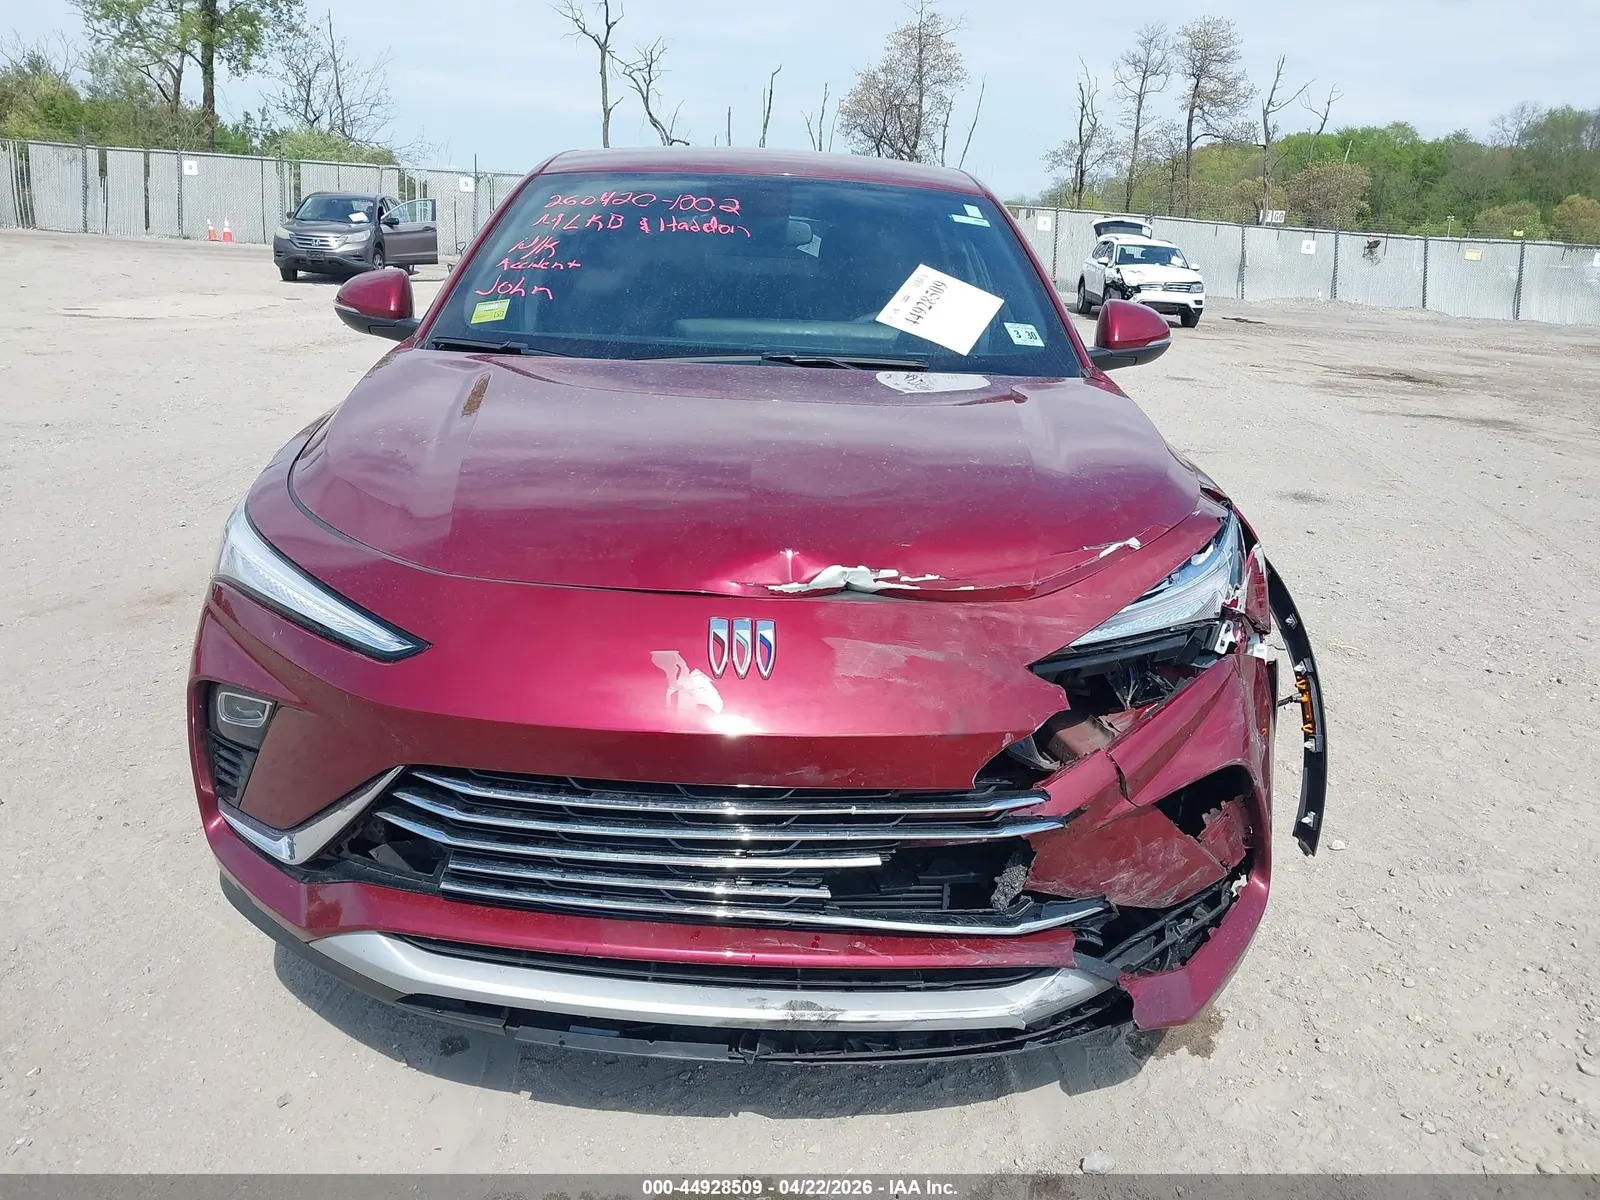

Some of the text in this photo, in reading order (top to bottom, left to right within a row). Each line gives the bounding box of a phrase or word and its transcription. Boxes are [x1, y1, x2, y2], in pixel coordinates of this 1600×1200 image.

[474, 274, 554, 300] John
[1013, 329, 1038, 340] 3 30
